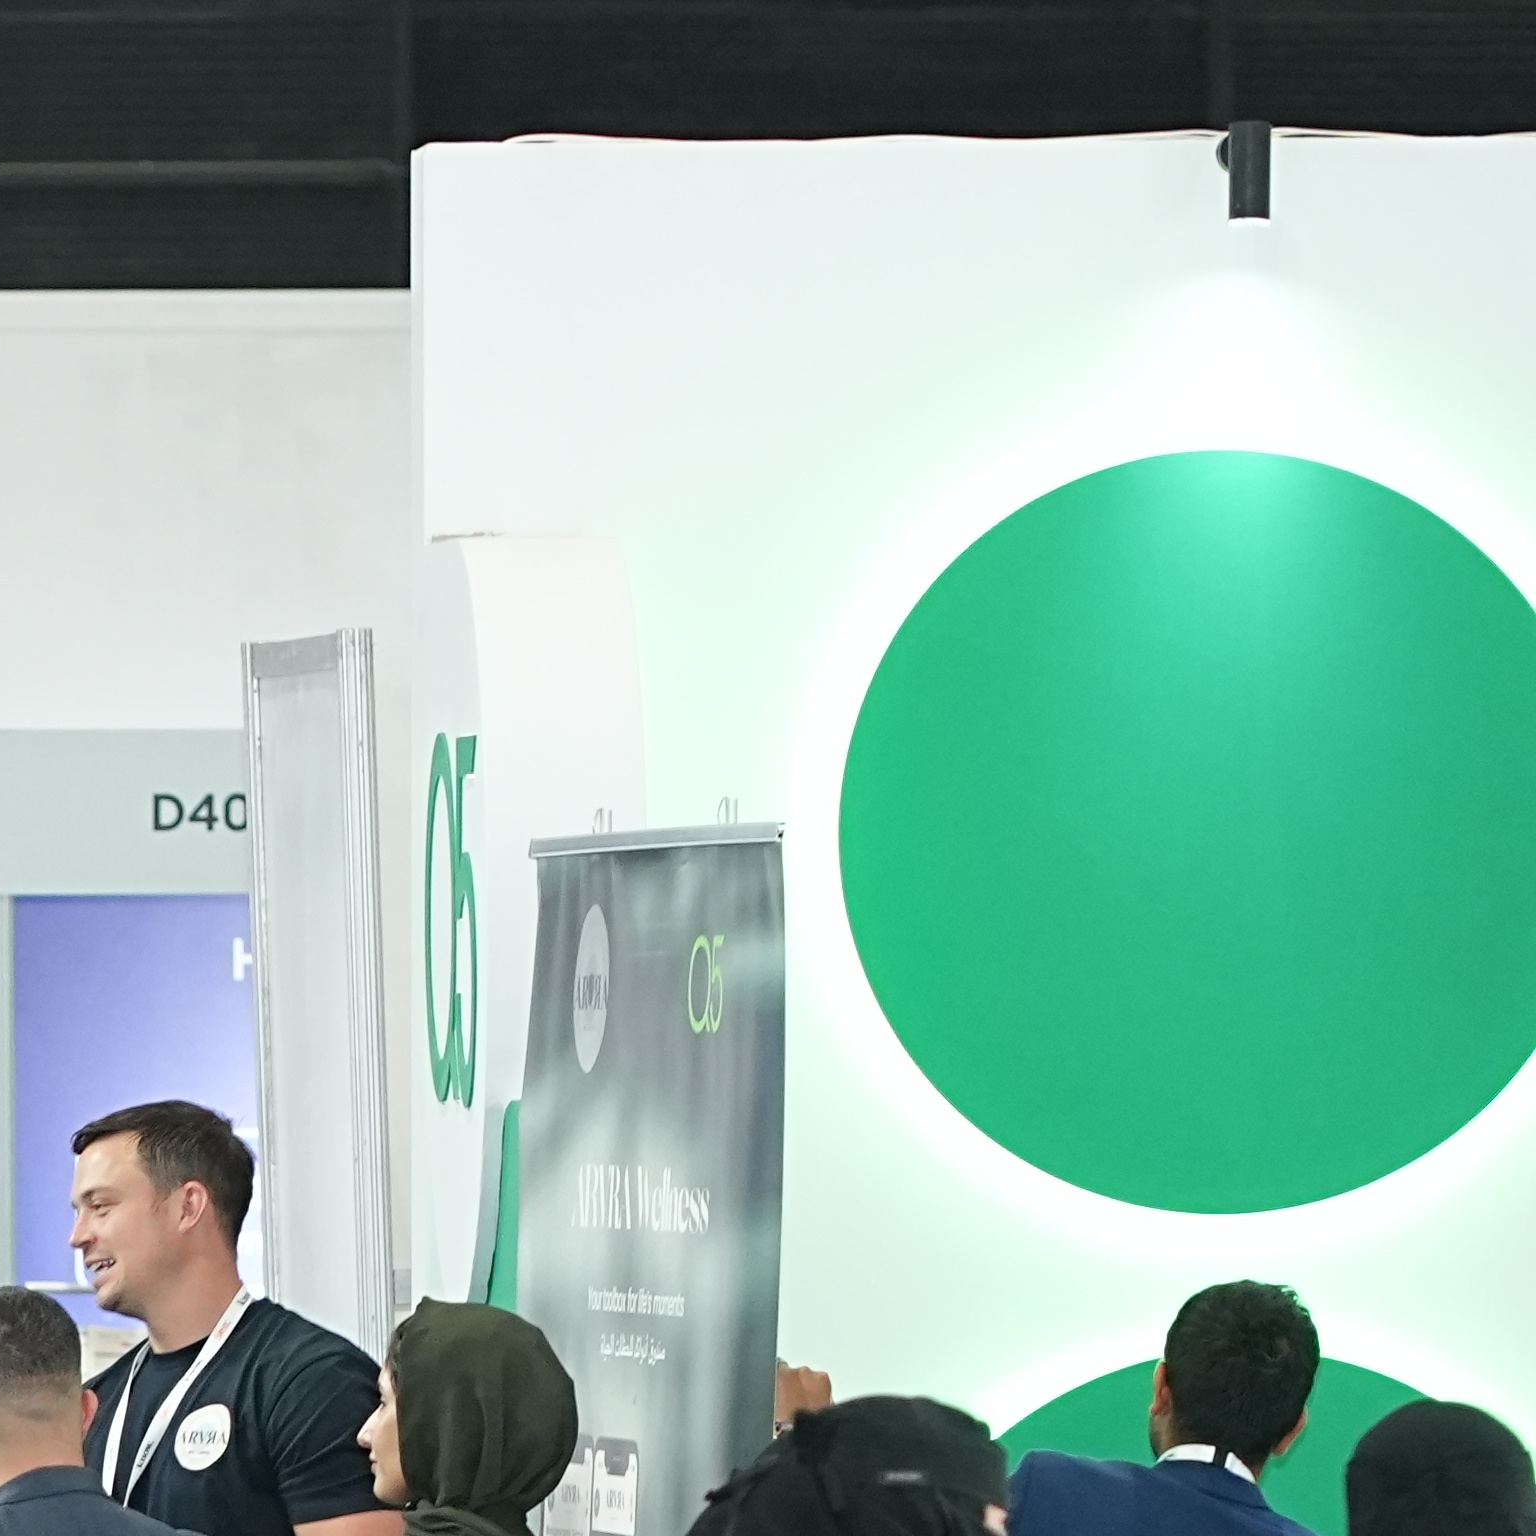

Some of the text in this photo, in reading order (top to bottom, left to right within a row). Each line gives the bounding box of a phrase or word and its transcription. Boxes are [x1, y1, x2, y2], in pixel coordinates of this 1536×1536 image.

[637, 1164, 710, 1235] Wellness
[603, 1286, 627, 1313] toolbox
[627, 1286, 638, 1314] for
[653, 1293, 685, 1317] moments
